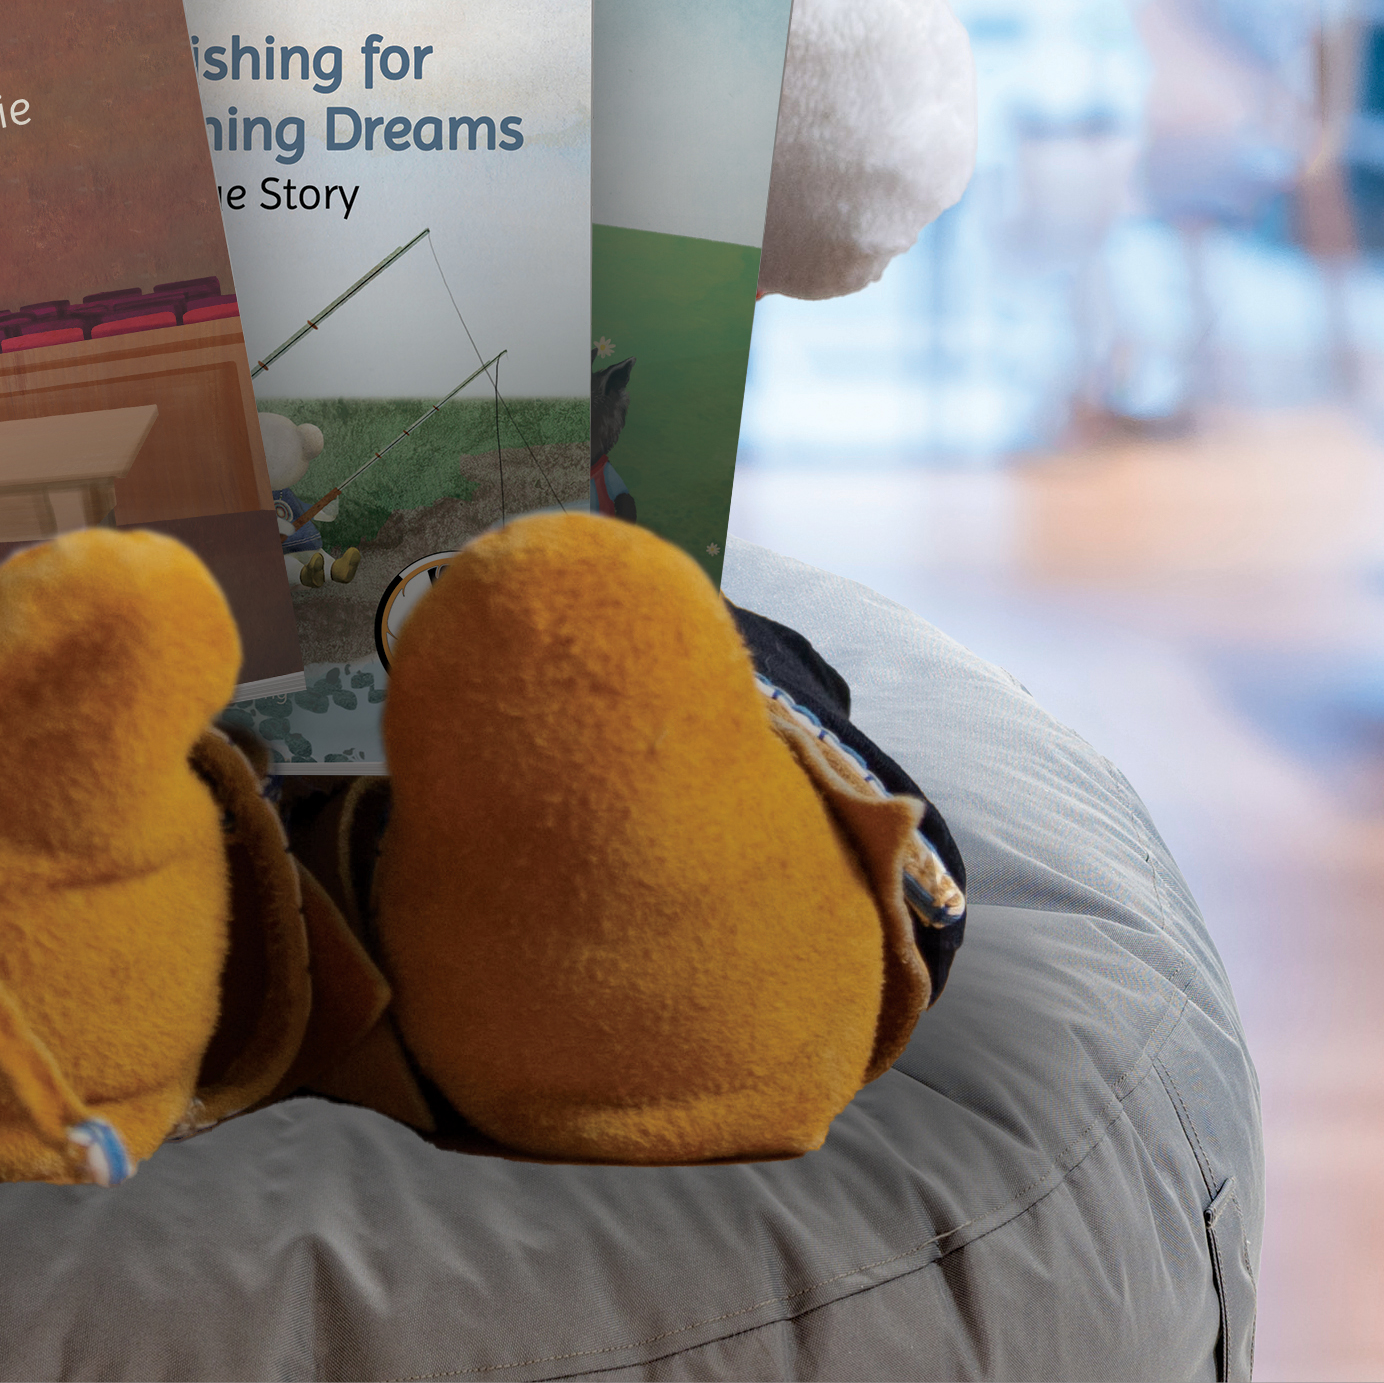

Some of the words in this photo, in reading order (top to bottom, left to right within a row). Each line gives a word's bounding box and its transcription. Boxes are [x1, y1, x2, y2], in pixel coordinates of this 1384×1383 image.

[191, 35, 343, 94] ishing
[361, 33, 433, 90] for
[326, 106, 524, 152] Dreams
[259, 177, 360, 220] Story
